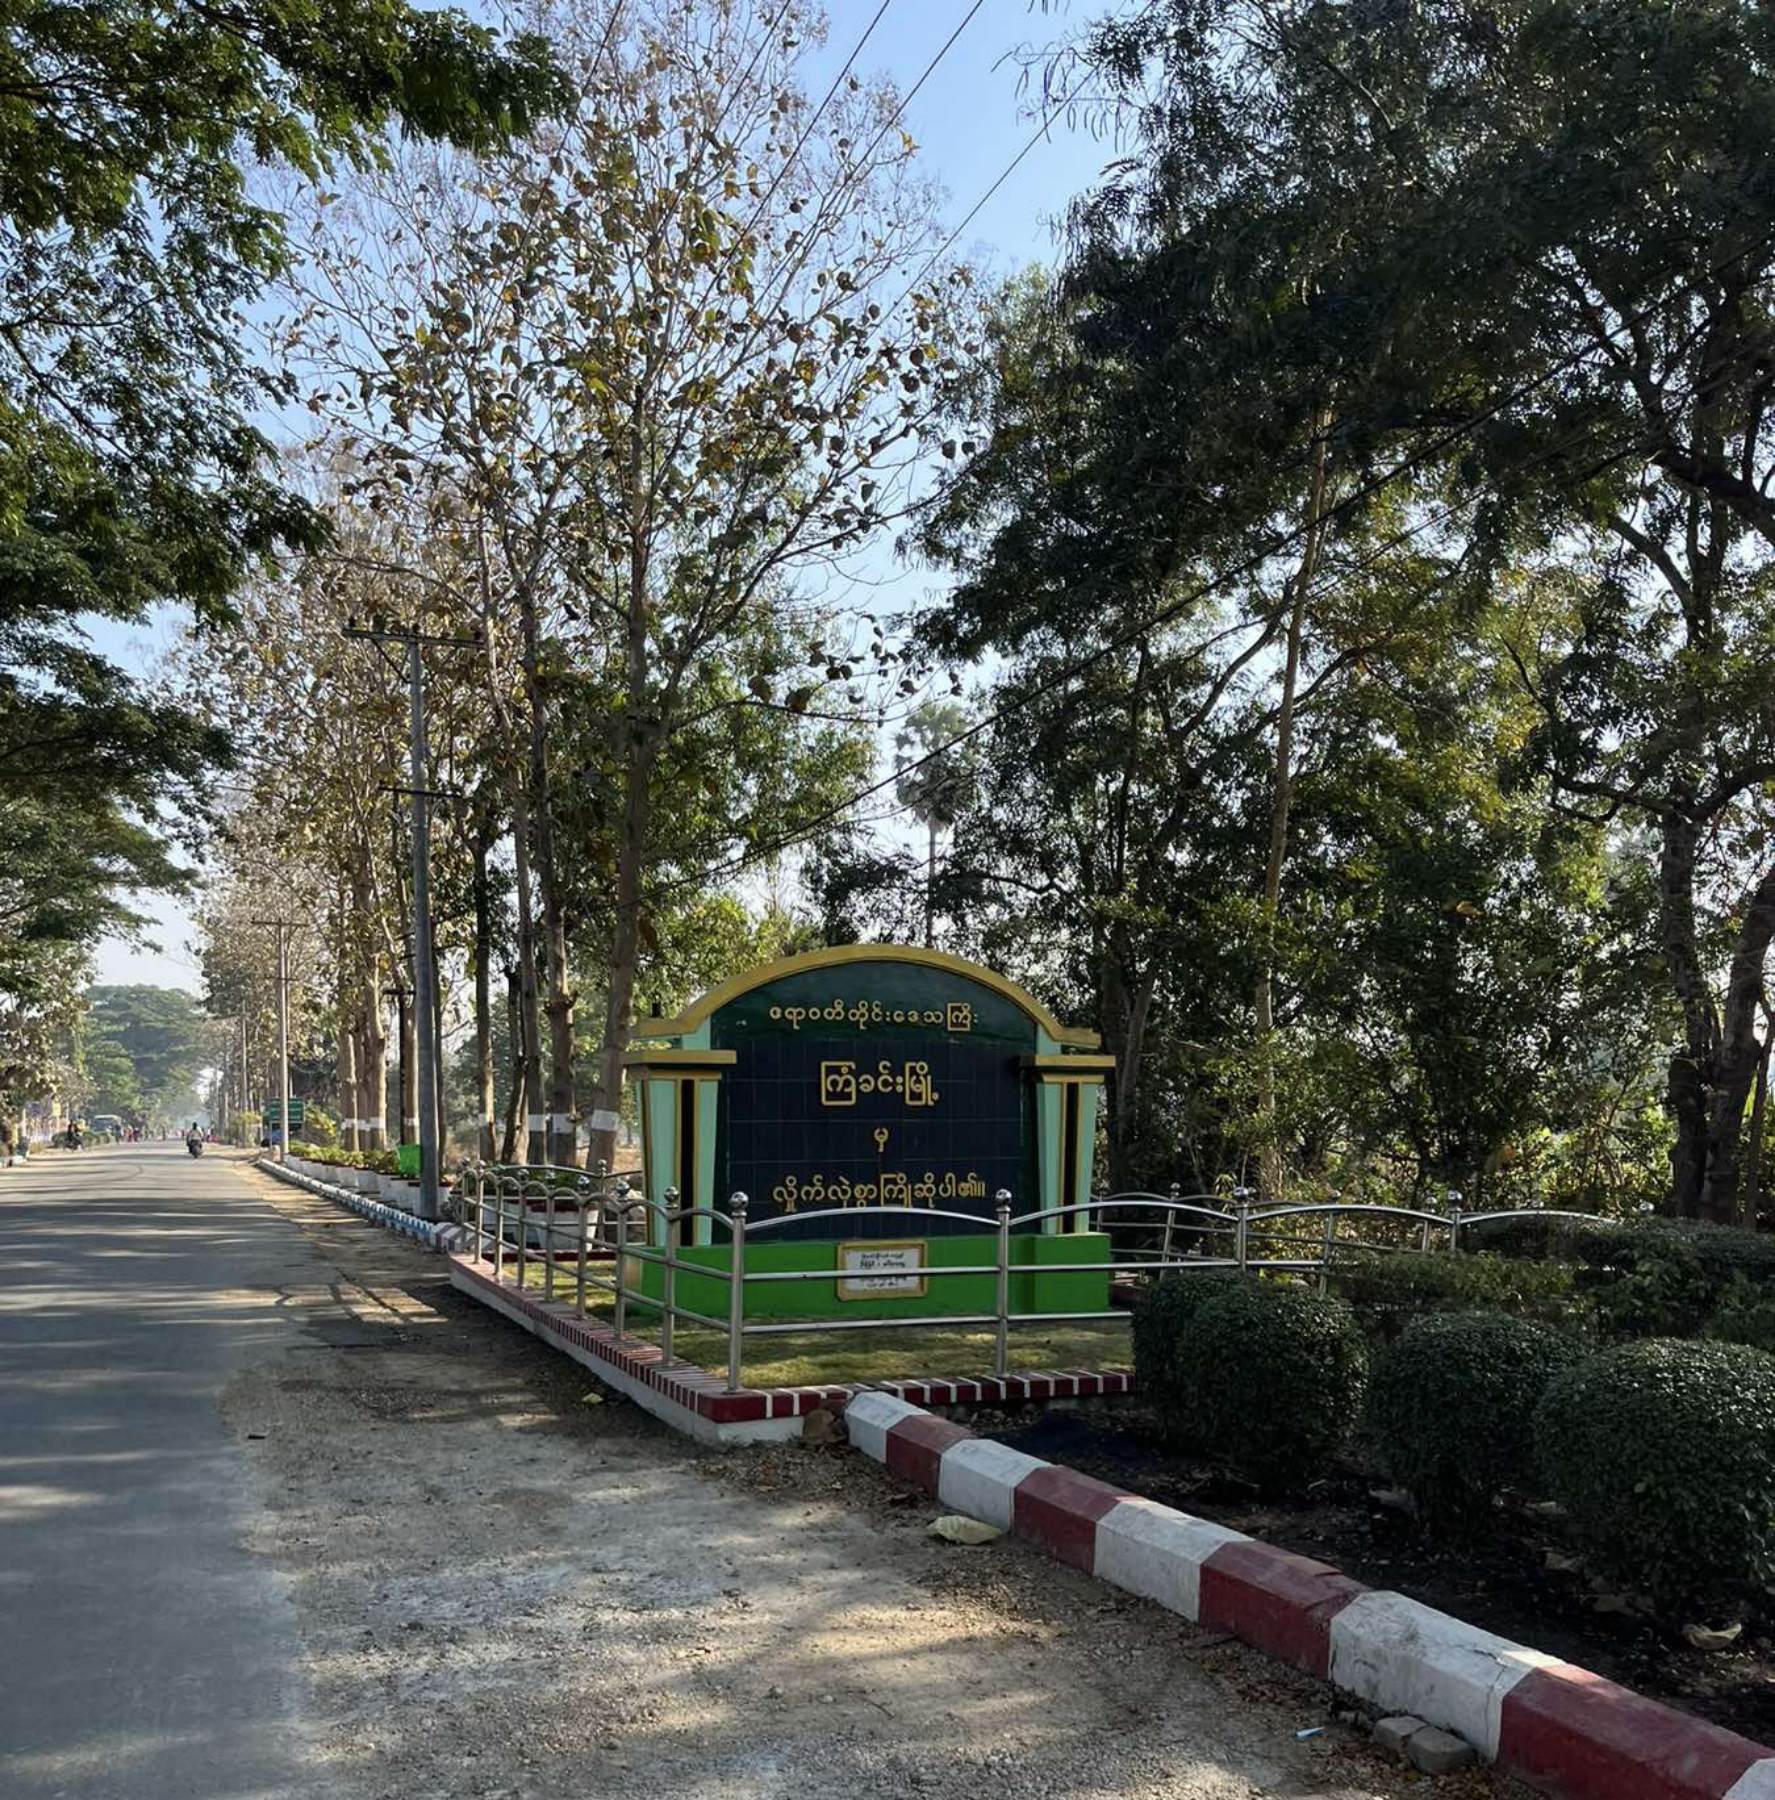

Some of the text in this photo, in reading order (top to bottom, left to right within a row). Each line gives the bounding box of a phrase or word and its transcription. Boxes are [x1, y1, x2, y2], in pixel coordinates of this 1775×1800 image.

[820, 1060, 940, 1106] ကြံခင်းမြို့
[873, 1127, 890, 1153] မှ
